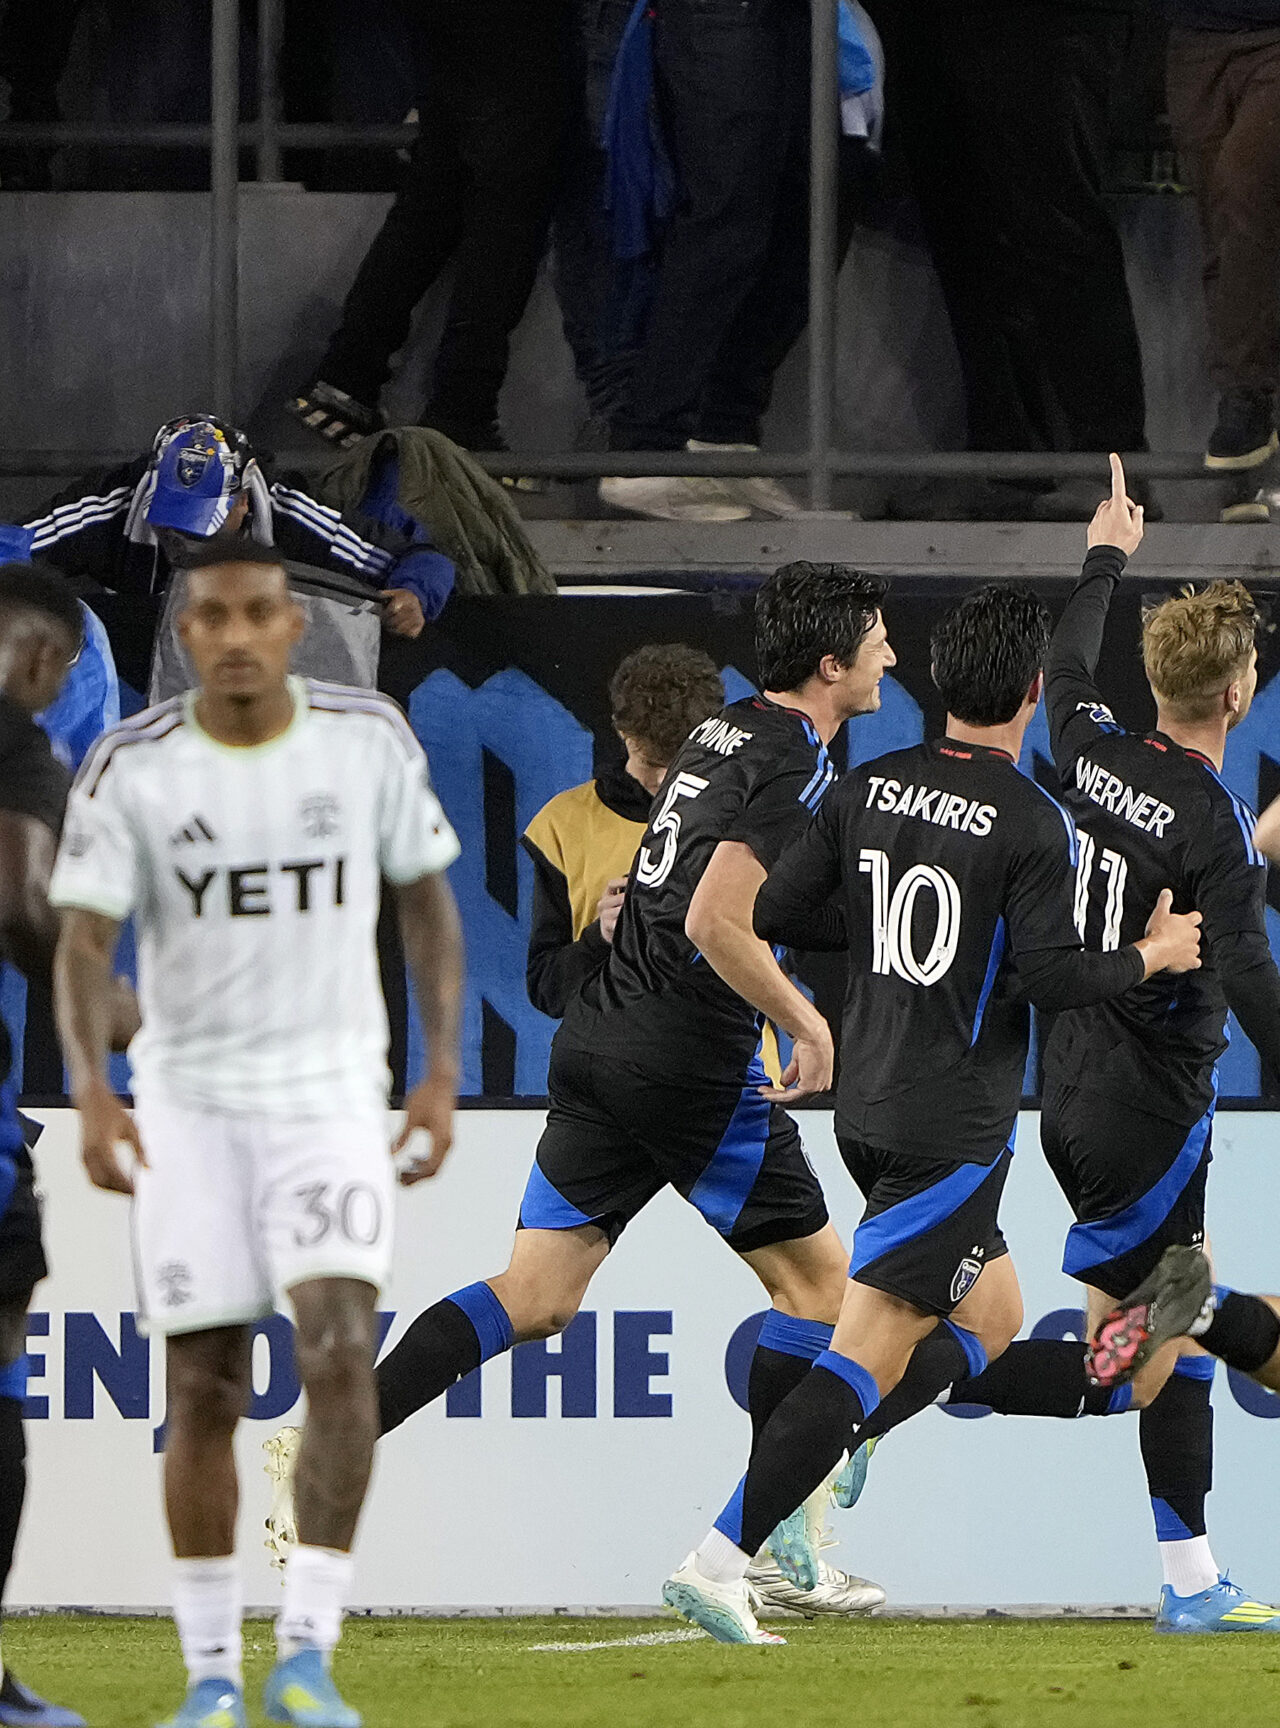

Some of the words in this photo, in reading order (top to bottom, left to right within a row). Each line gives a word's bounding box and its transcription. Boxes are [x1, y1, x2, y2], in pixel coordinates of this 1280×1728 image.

[636, 771, 710, 888] 5
[865, 776, 997, 837] TSAKIRIS
[1076, 756, 1176, 839] WERNER
[173, 855, 345, 918] YETI
[858, 848, 961, 987] 10
[1073, 828, 1128, 953] 11
[294, 1181, 383, 1247] 30
